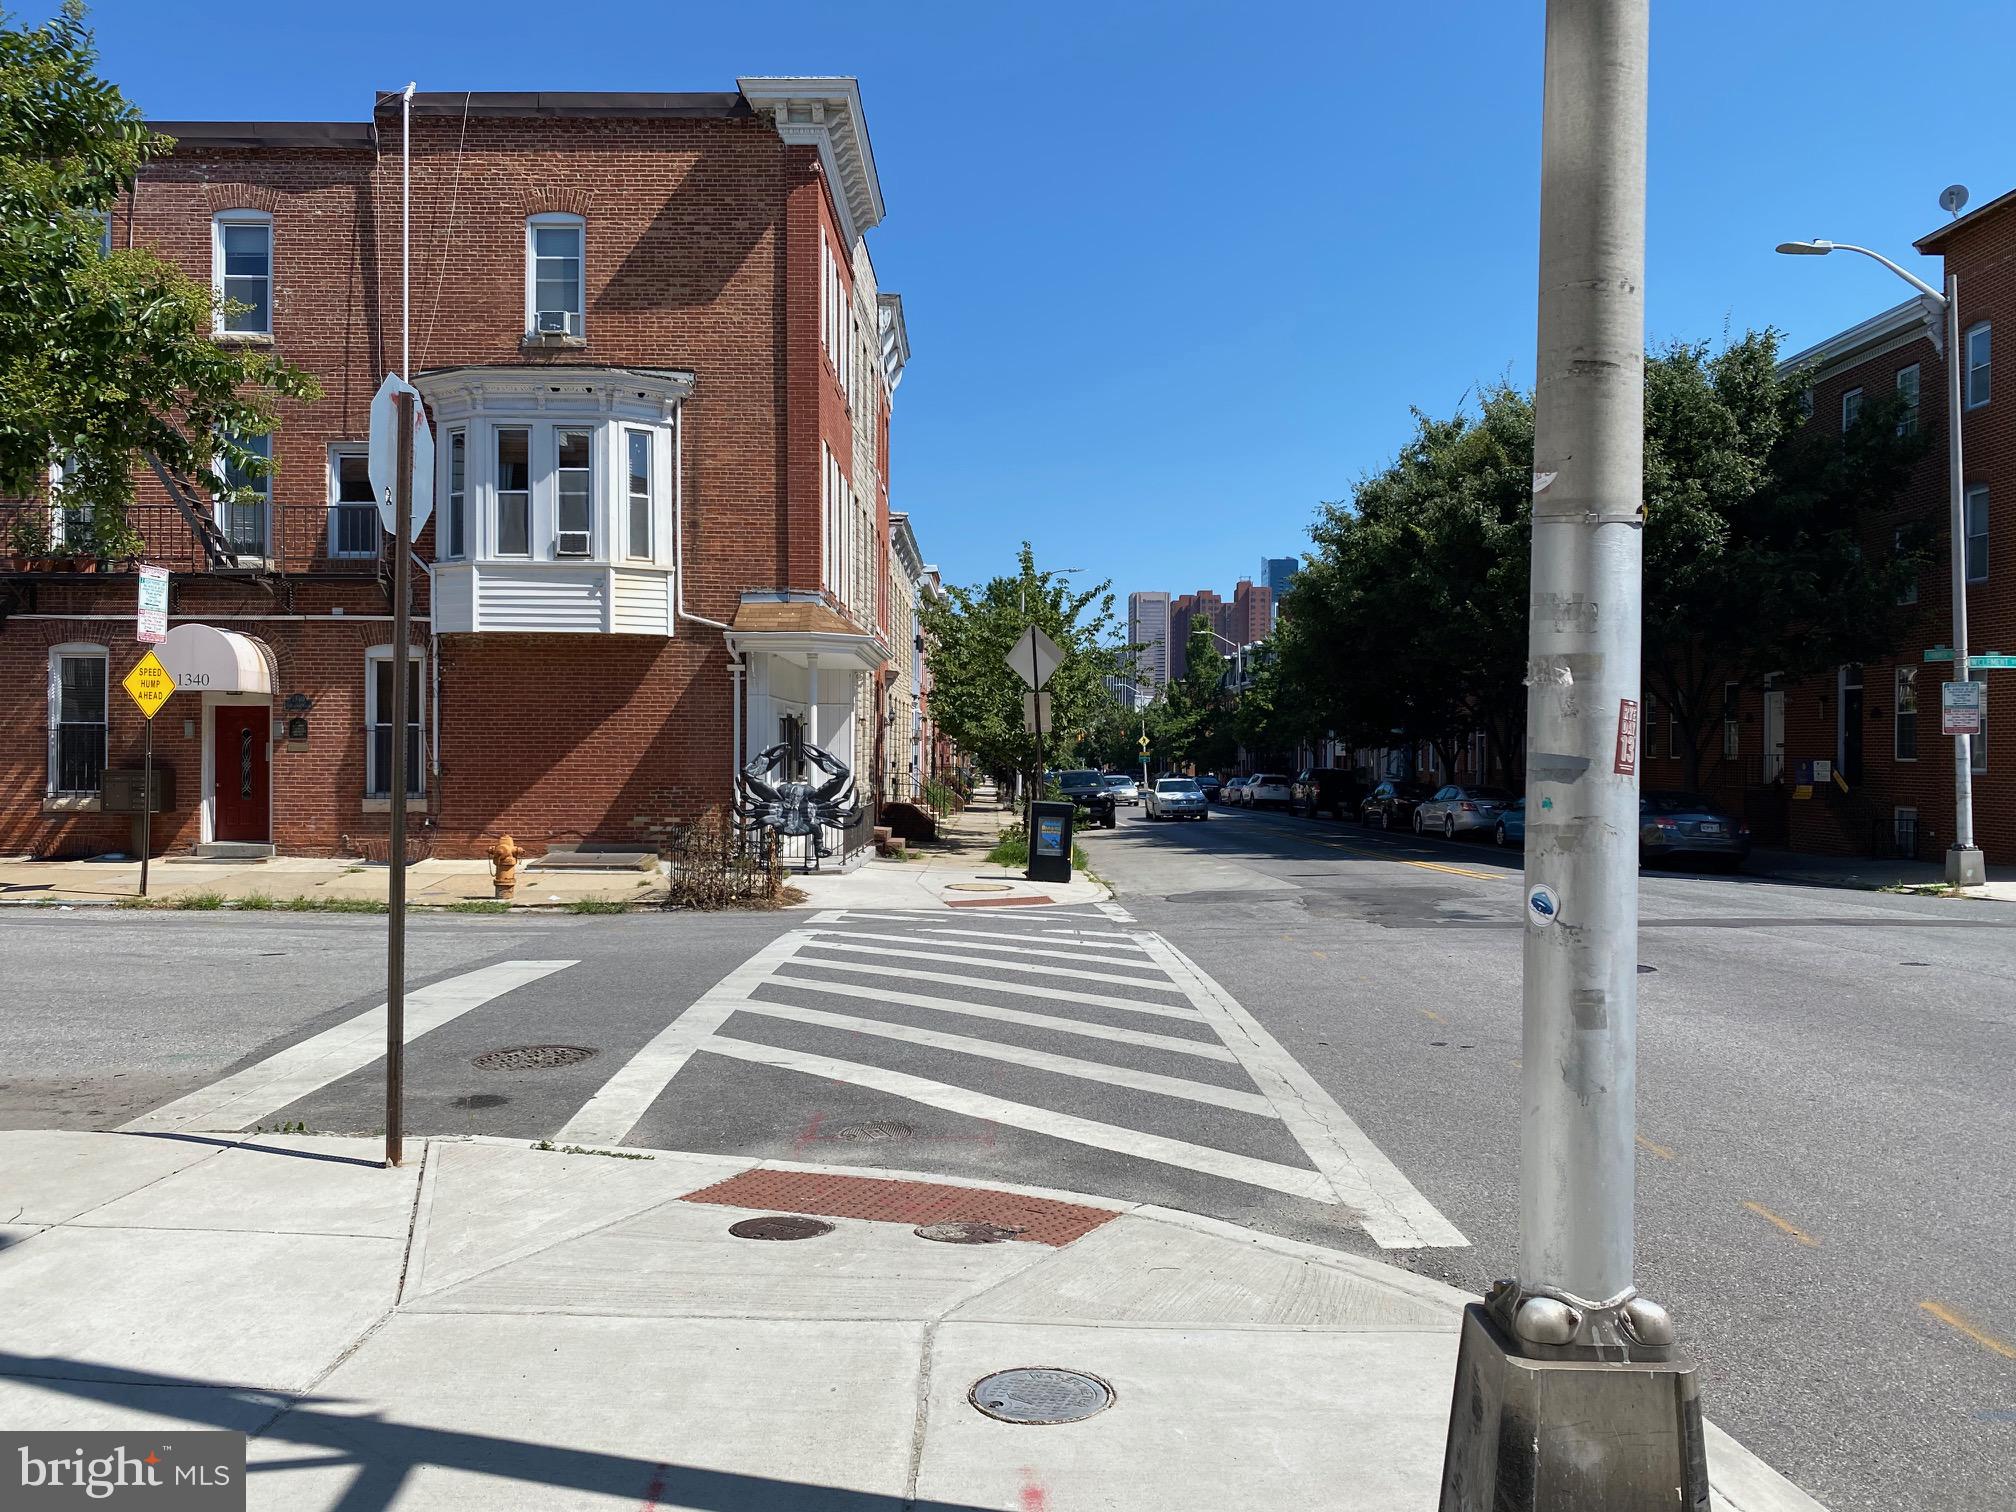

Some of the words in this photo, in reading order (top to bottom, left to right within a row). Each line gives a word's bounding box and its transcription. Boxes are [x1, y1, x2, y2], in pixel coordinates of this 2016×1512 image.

[139, 667, 162, 677] SPEED
[140, 680, 161, 688] HUMP
[177, 673, 210, 687] 1340
[138, 691, 163, 700] AHEAD
[1620, 734, 1635, 763] 13
